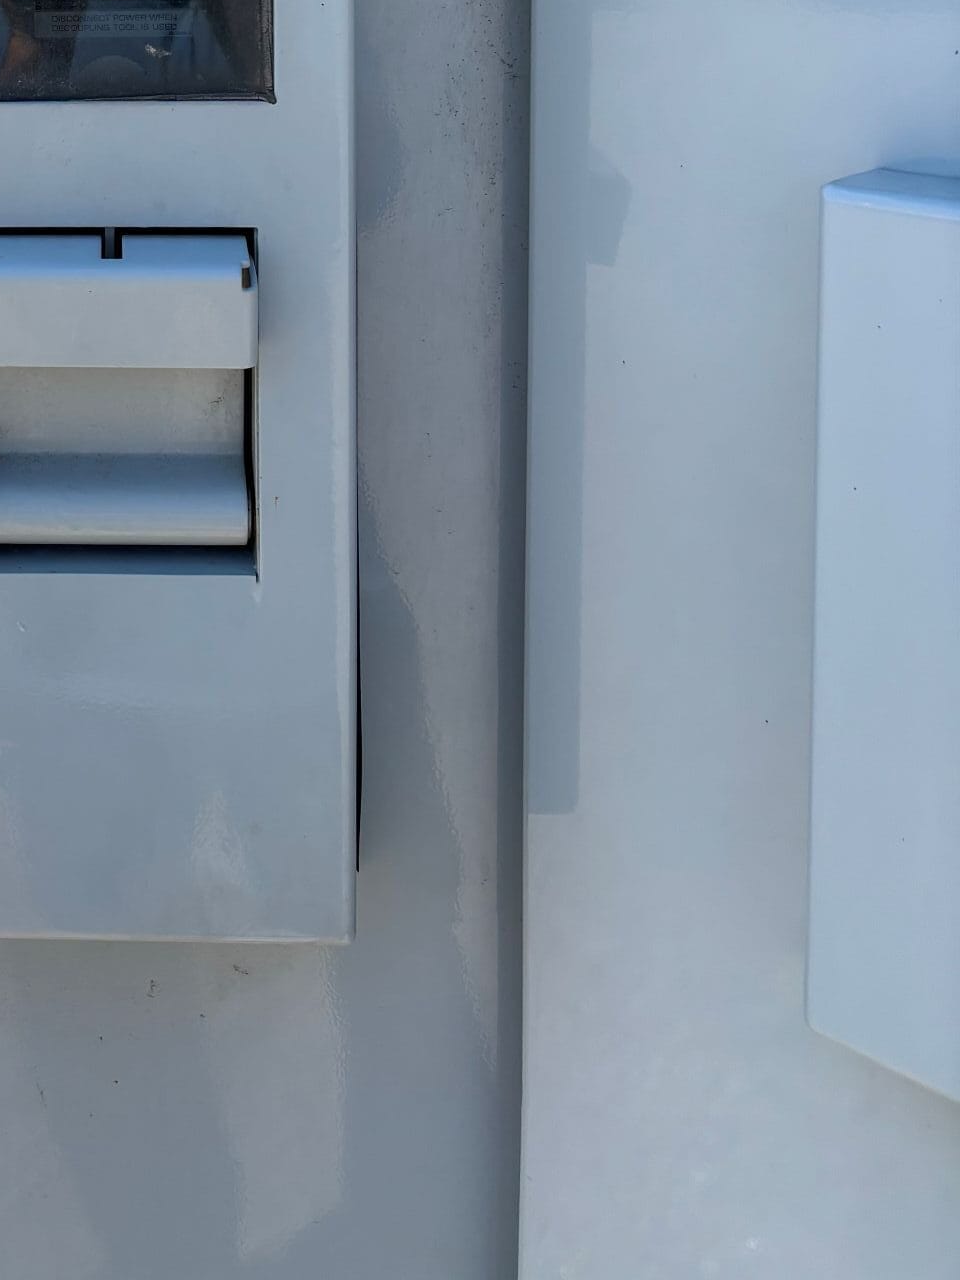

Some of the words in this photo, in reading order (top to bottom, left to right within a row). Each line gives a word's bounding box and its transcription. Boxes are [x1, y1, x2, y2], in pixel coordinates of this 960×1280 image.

[51, 14, 112, 23] DISCONNECT
[113, 14, 147, 22] POWER
[149, 13, 178, 22] WHEN
[51, 23, 111, 32] DECOUPLING
[113, 23, 137, 32] TOOL
[140, 23, 149, 31] IS
[152, 23, 177, 31] USED
